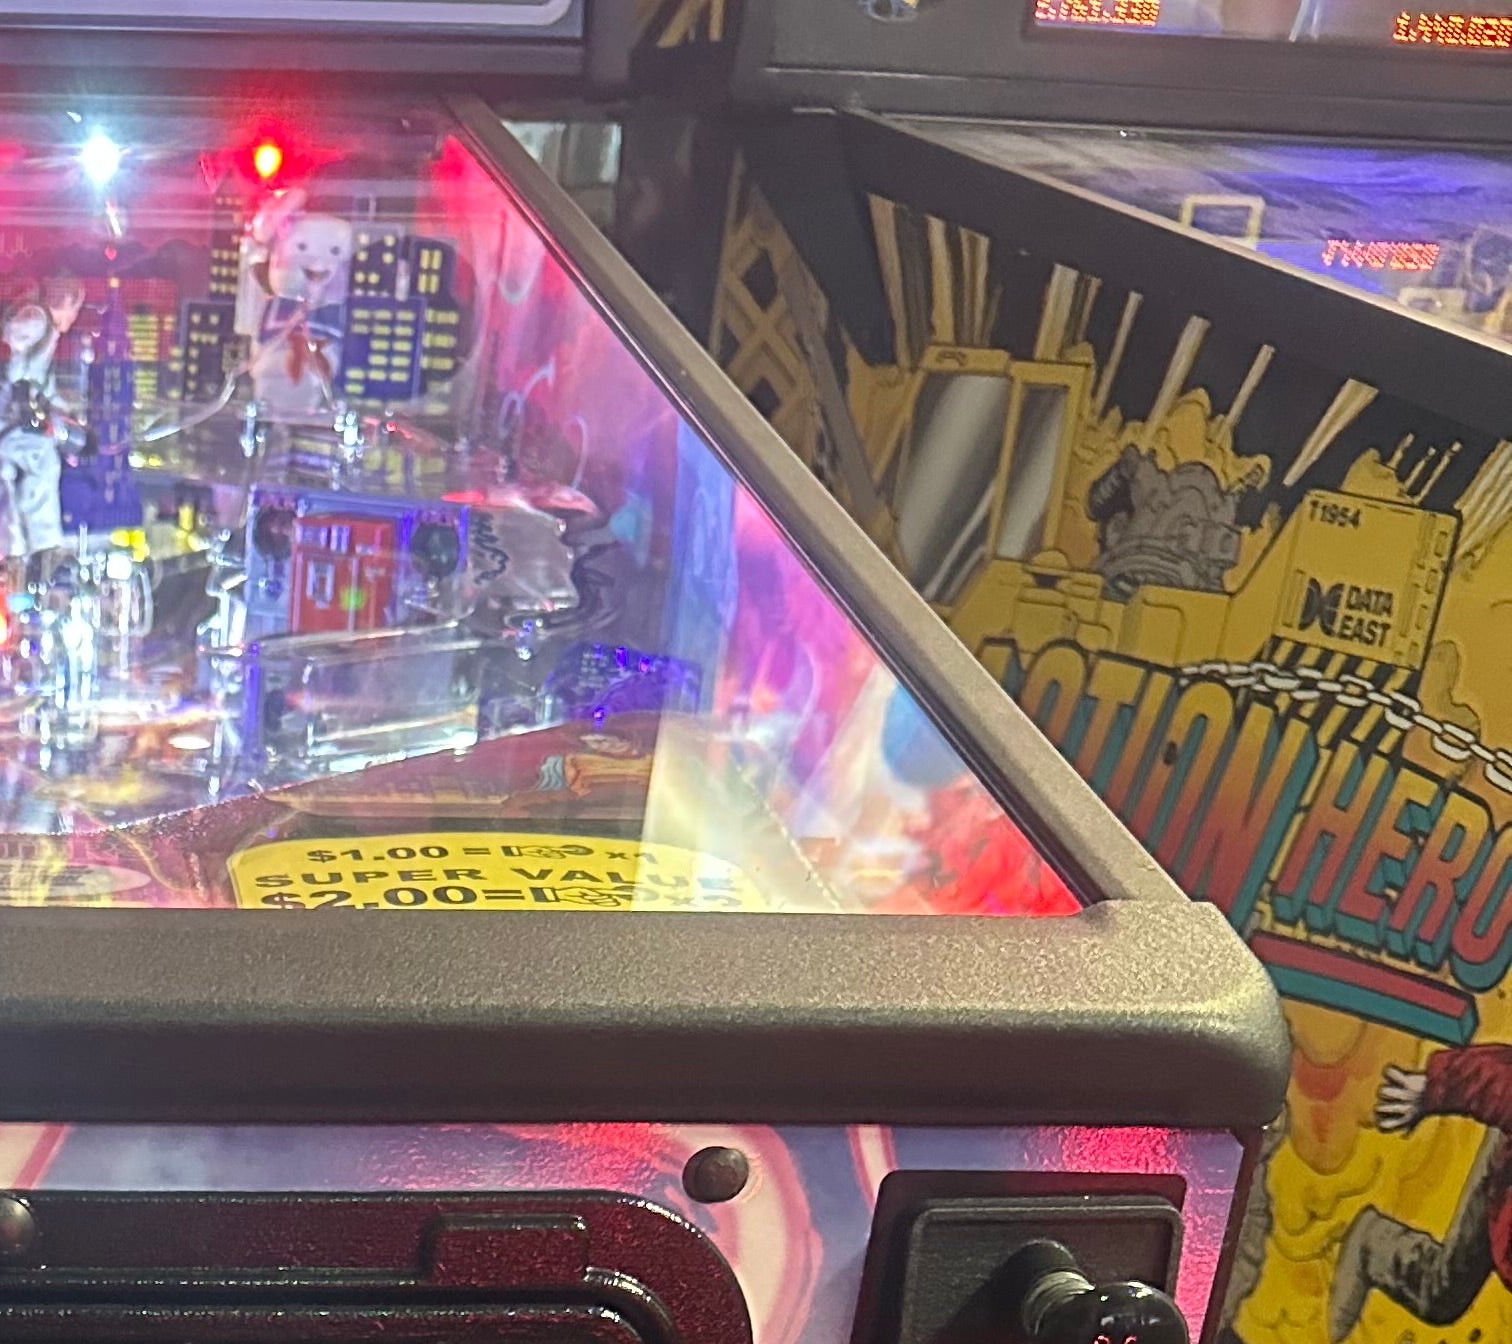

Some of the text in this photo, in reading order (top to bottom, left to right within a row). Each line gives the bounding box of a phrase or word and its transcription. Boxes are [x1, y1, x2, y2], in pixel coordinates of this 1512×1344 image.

[1345, 585, 1394, 618] DATA
[1336, 614, 1392, 647] EAST
[306, 845, 449, 864] $1.00
[254, 866, 743, 892] SUPER VALUE
